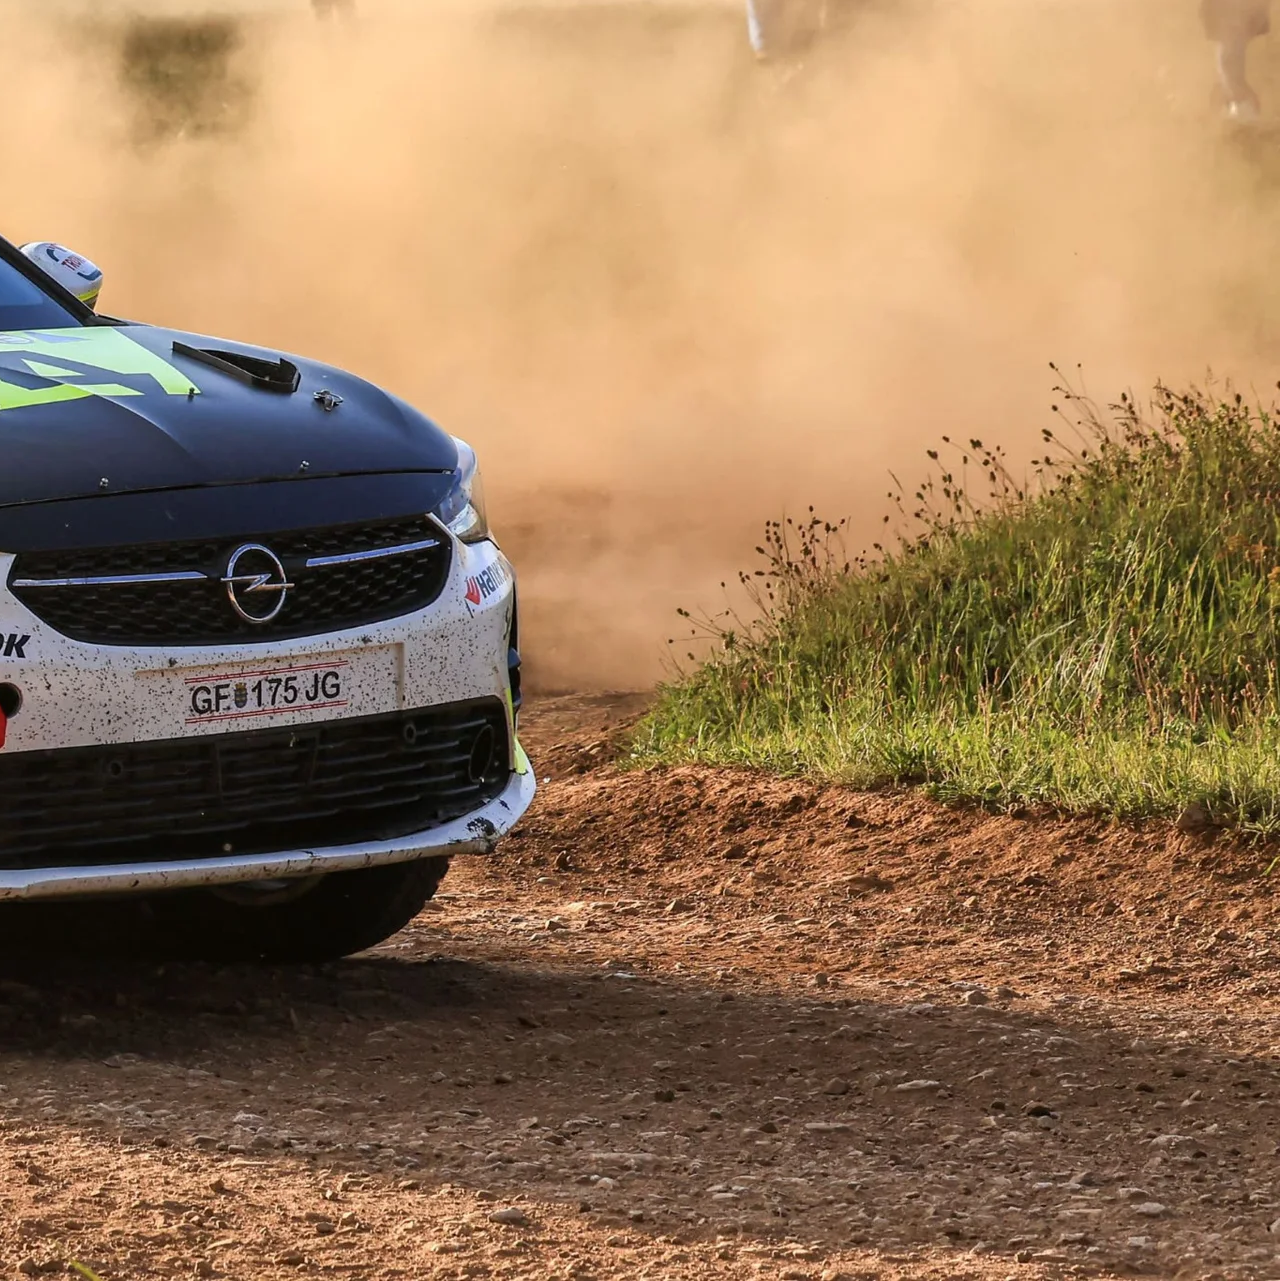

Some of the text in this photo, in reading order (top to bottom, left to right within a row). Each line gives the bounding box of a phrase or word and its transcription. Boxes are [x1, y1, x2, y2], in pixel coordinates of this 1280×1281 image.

[192, 671, 340, 715] GF 175 JG
